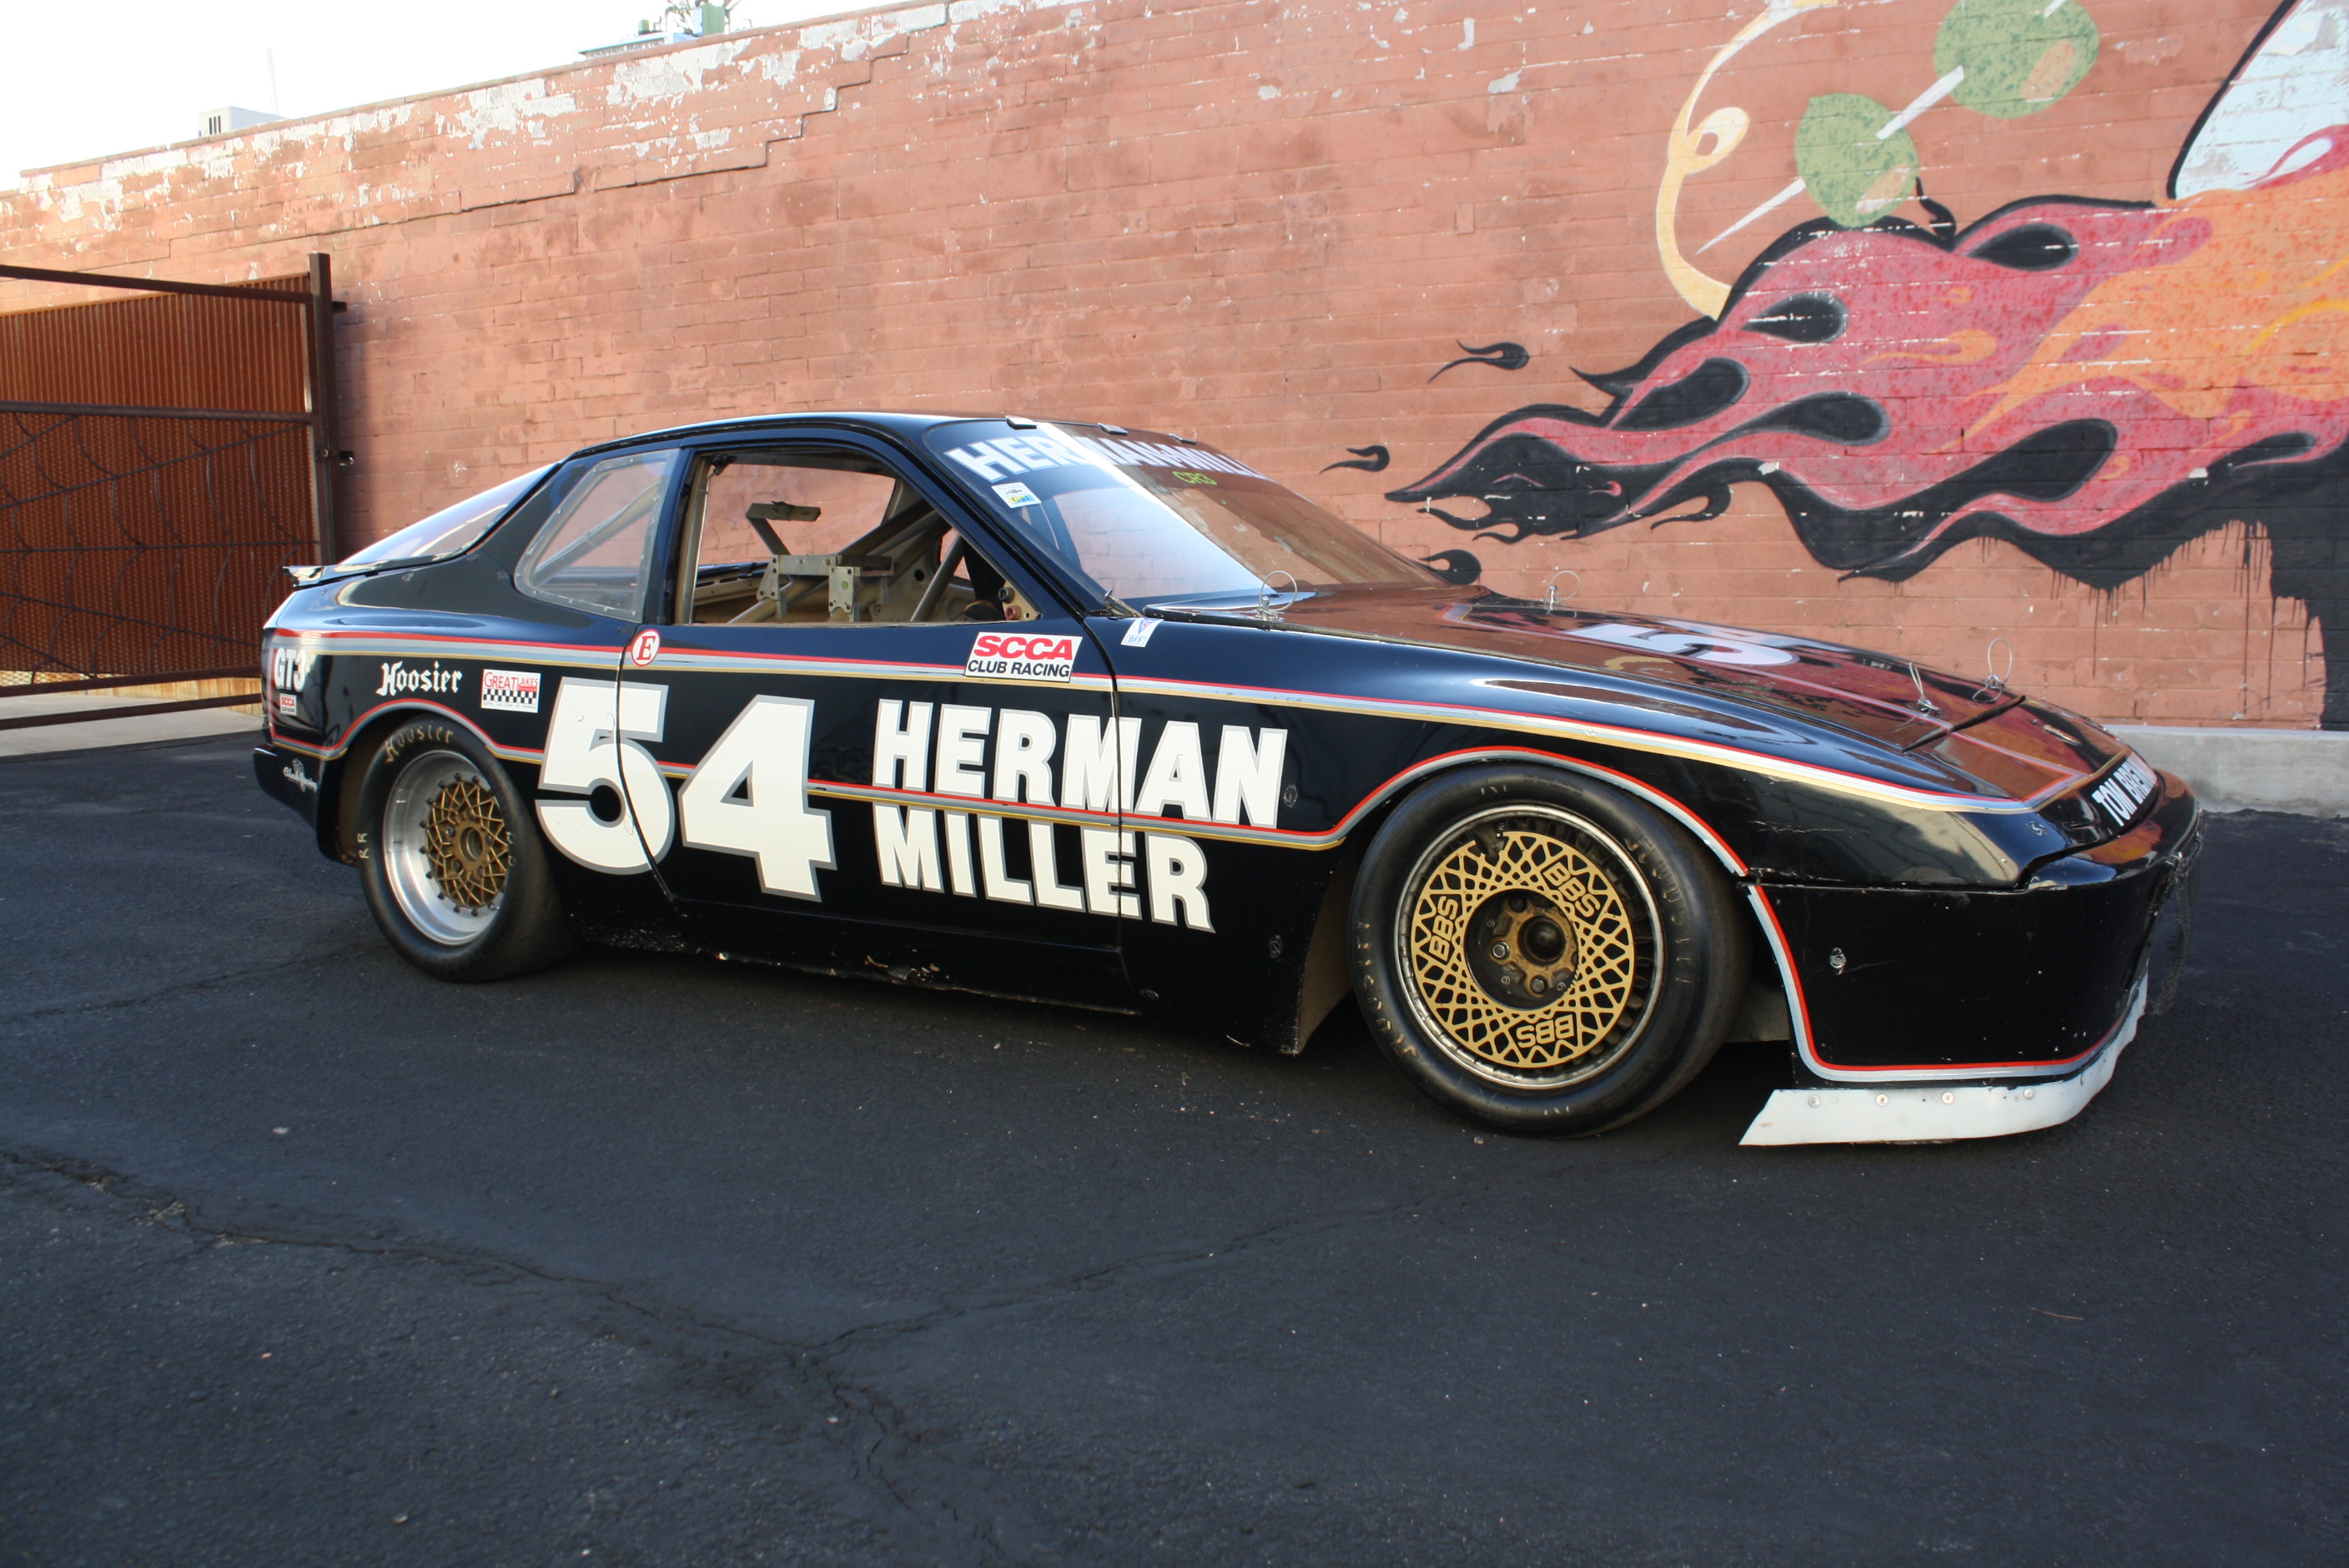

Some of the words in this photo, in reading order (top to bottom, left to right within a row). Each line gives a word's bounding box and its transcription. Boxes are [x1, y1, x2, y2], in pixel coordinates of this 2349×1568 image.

[274, 647, 306, 692] GT3
[968, 660, 1008, 674] CLUB
[1010, 662, 1070, 678] RACING
[973, 635, 1073, 661] SCCA
[376, 661, 463, 696] Hoosier
[484, 671, 517, 691] GREAT
[517, 677, 539, 687] LAKES
[873, 698, 1288, 829] HERMAN
[535, 676, 837, 902] 54
[2091, 777, 2137, 827] TOM
[873, 802, 1216, 933] MILLER
[1542, 862, 1601, 918] BBS
[1428, 895, 1460, 963] BBS
[1516, 1013, 1576, 1048] BBS
